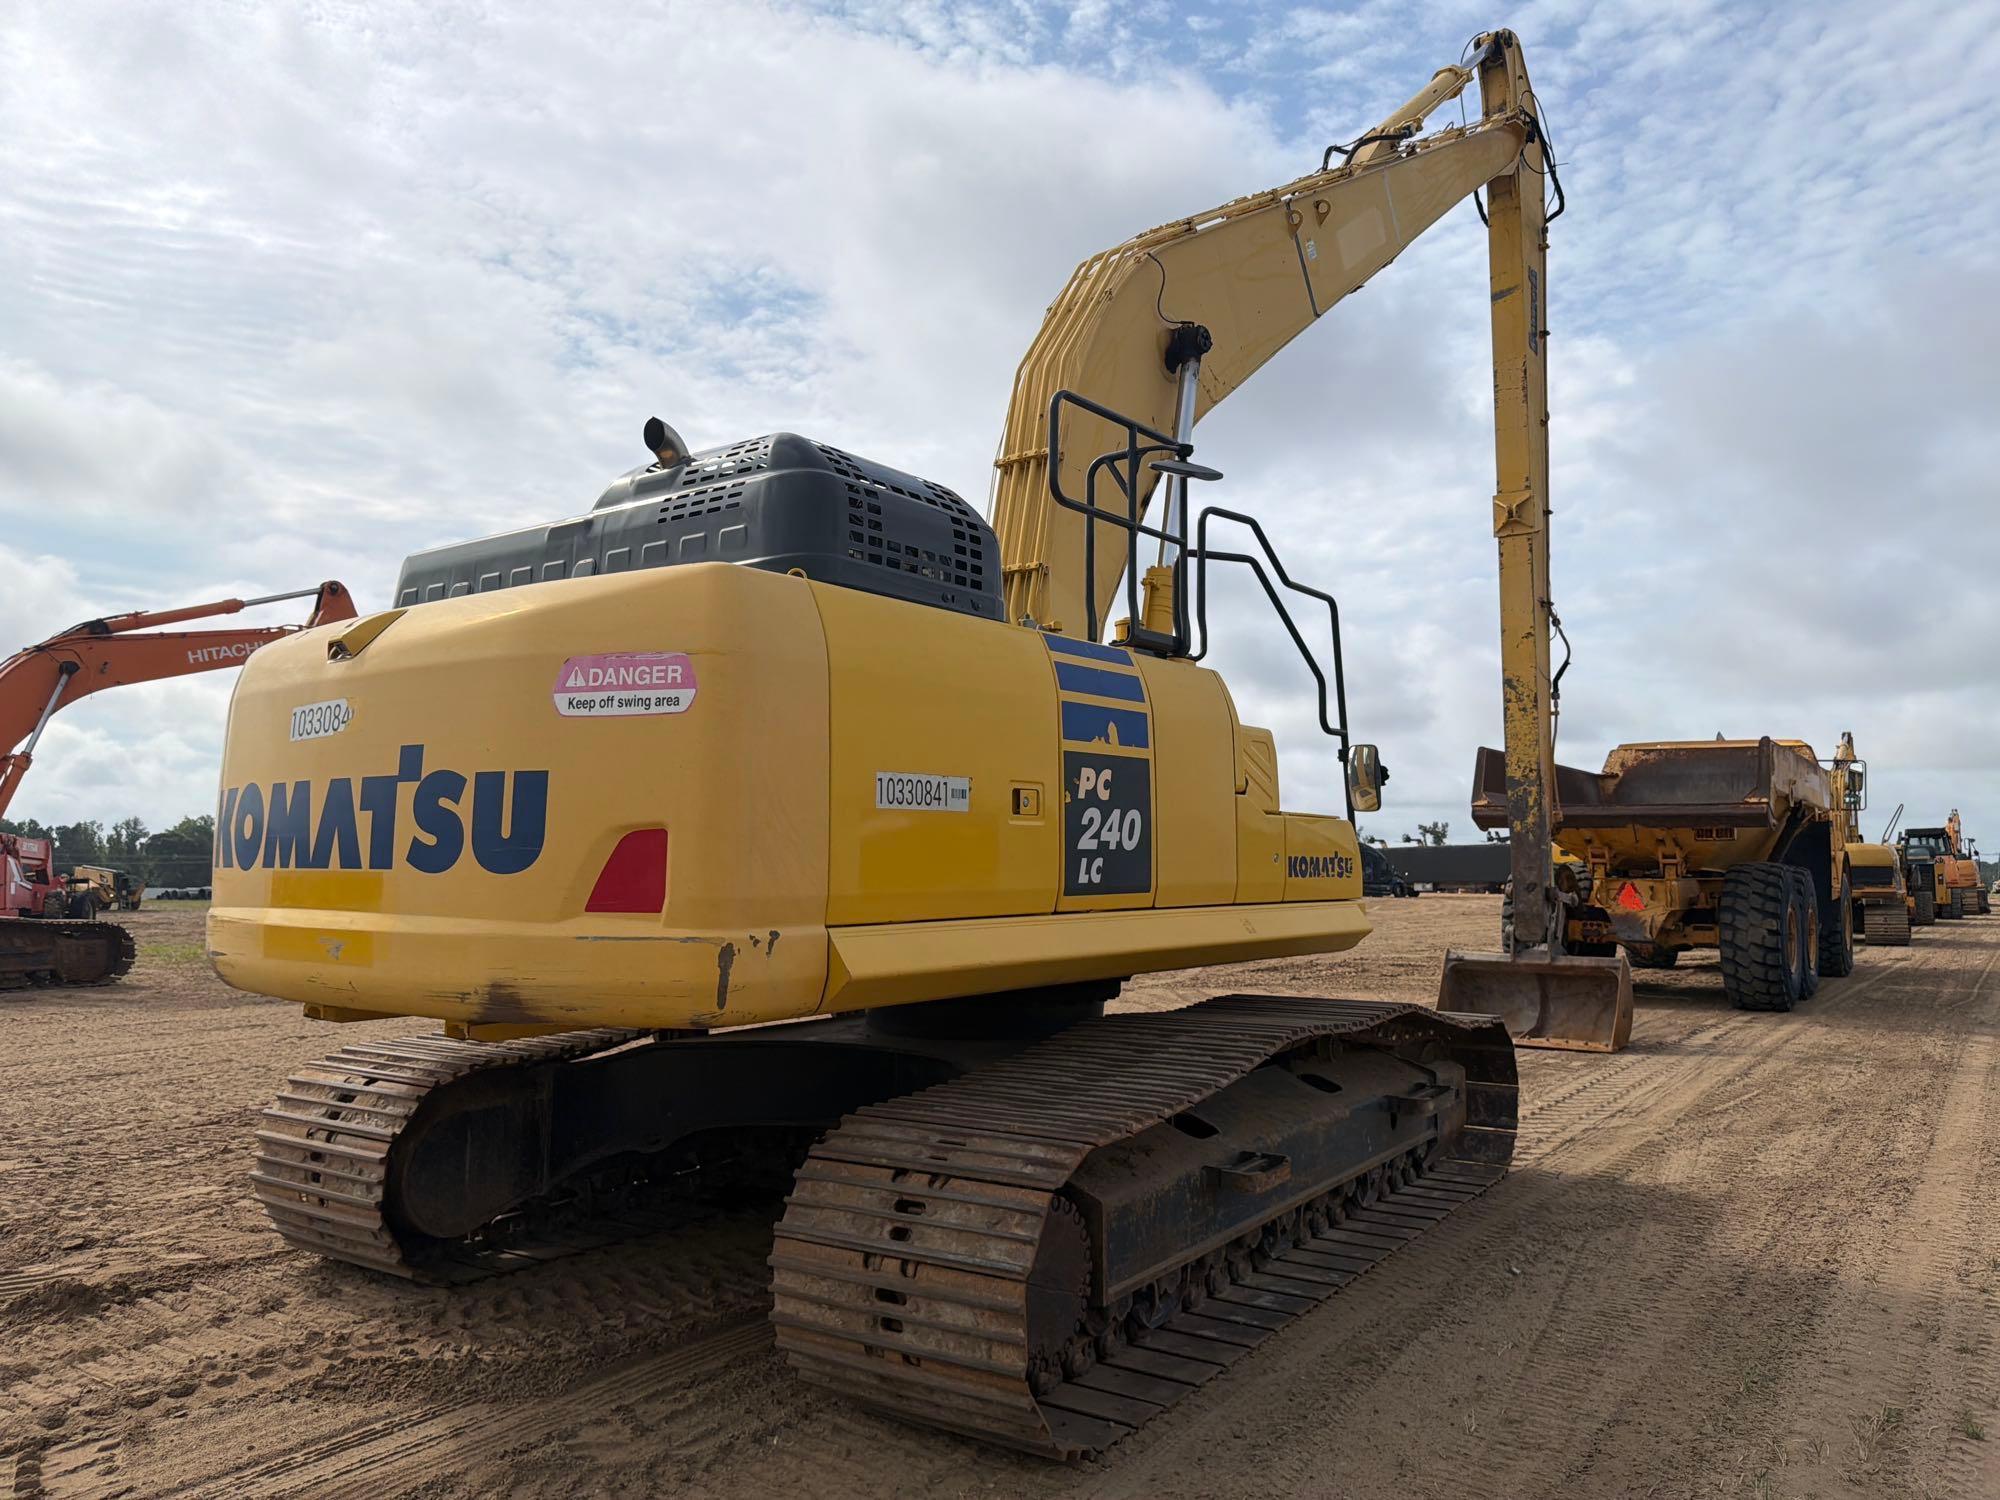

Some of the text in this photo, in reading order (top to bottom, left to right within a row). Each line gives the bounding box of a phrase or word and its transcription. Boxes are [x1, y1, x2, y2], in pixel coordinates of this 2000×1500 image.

[588, 665, 683, 687] DANGER
[567, 695, 680, 712] Keep off swing area
[877, 777, 948, 807] 10330841
[1077, 767, 1112, 800] PC
[215, 744, 549, 875] KOMATSU
[1077, 807, 1142, 851] 240
[1078, 857, 1104, 884] LC
[1287, 851, 1353, 879] KOMATSU
